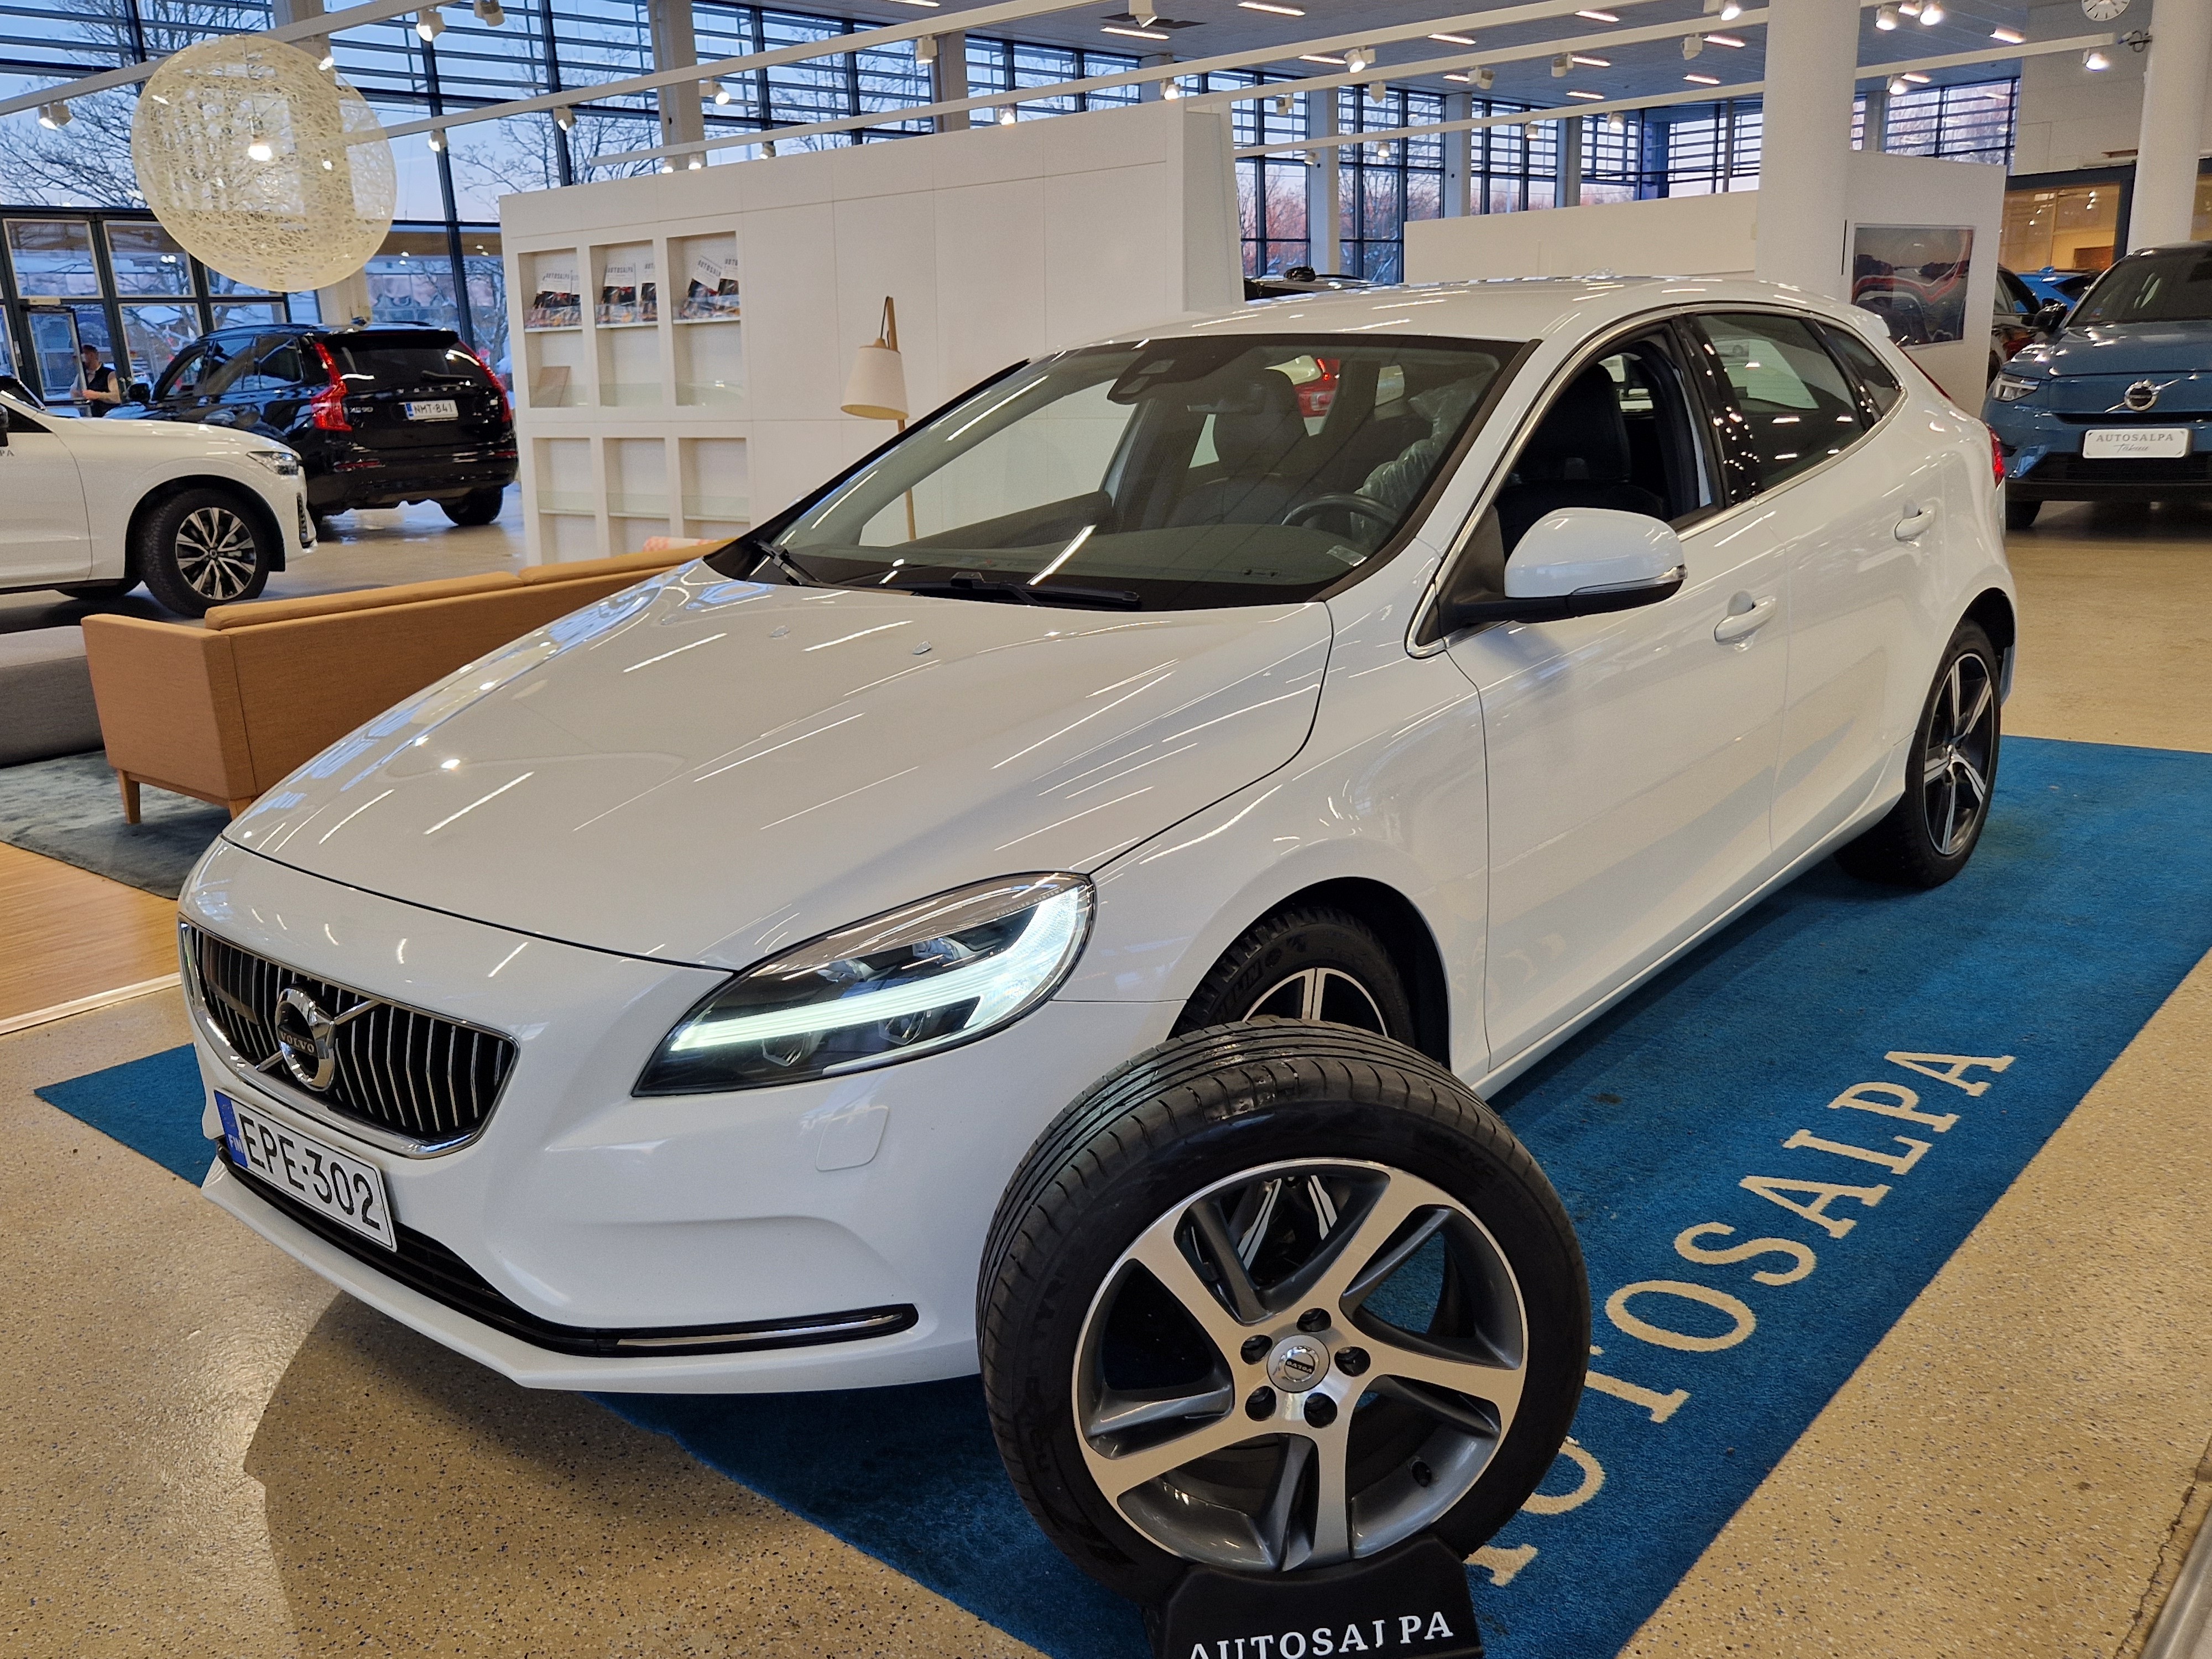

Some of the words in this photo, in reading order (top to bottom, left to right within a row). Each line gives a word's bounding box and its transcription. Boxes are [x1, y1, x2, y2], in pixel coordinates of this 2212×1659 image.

[414, 403, 453, 413] NMT-841
[2096, 434, 2173, 442] AUTOSALPA
[2114, 444, 2150, 452] Takuu
[280, 1030, 315, 1053] VOLVO
[229, 1134, 244, 1154] FIN
[238, 1113, 382, 1231] EPE-302
[1463, 1050, 2016, 1587] TOSALPA
